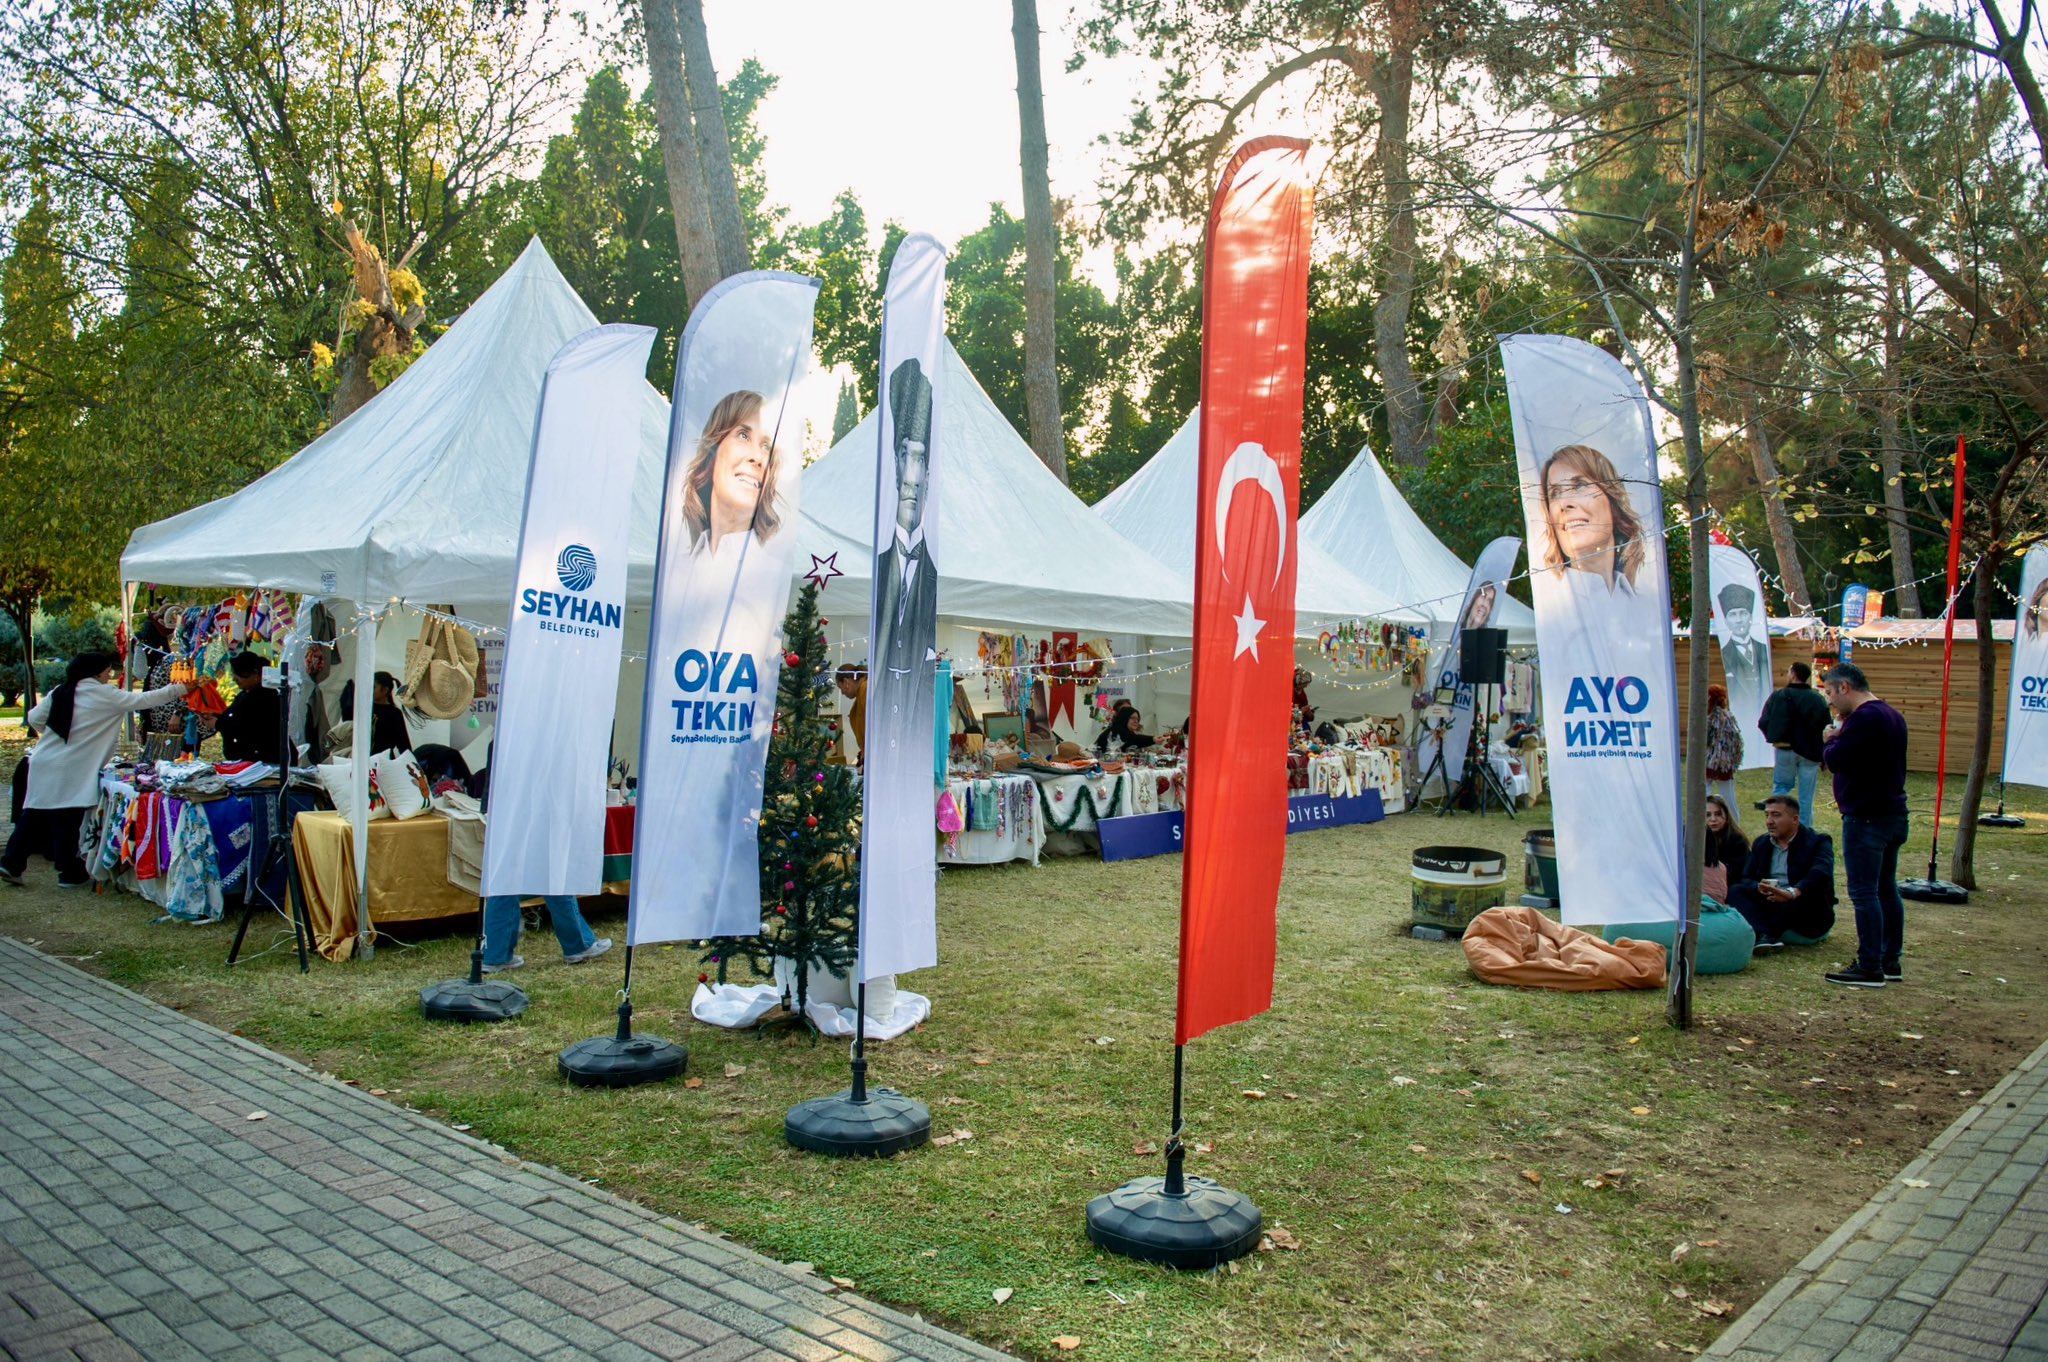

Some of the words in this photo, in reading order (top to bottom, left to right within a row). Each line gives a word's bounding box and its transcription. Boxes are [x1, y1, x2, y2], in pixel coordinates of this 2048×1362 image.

[521, 588, 621, 629] SEYHAN
[675, 649, 757, 693] OYA
[2021, 676, 2048, 693] OY
[2020, 695, 2048, 708] TEK
[671, 734, 696, 744] Seyha
[1288, 802, 1335, 823] DİYESİ
